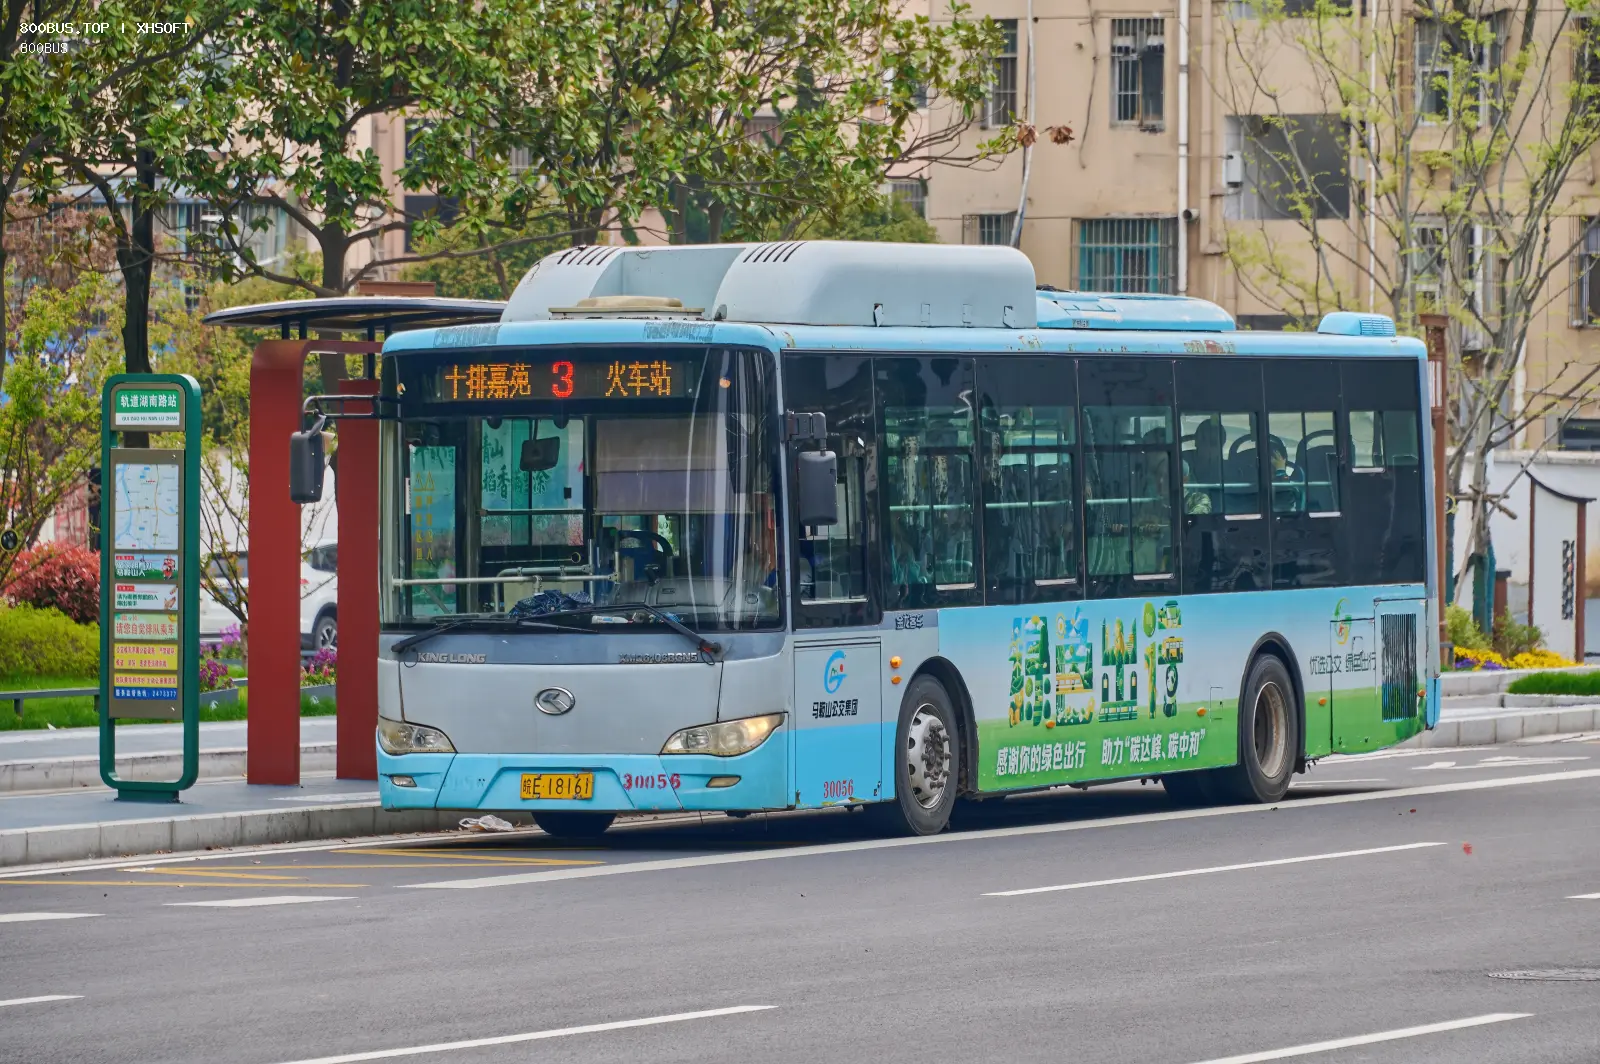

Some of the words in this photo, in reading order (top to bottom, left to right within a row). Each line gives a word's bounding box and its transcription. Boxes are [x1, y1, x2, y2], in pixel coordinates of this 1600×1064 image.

[445, 361, 532, 400] 十排嘉苑
[551, 360, 574, 398] 3
[605, 361, 672, 397] 火车站
[120, 394, 177, 408] 轨道湖南路站
[417, 652, 447, 664] KING
[448, 653, 487, 664] LONG
[1008, 600, 1184, 729] 绿色出行
[812, 698, 859, 719] 马鞍山公交集团
[996, 740, 1087, 776] 感谢你的绿色出行
[622, 773, 681, 790] 30056
[823, 779, 854, 798] 30056
